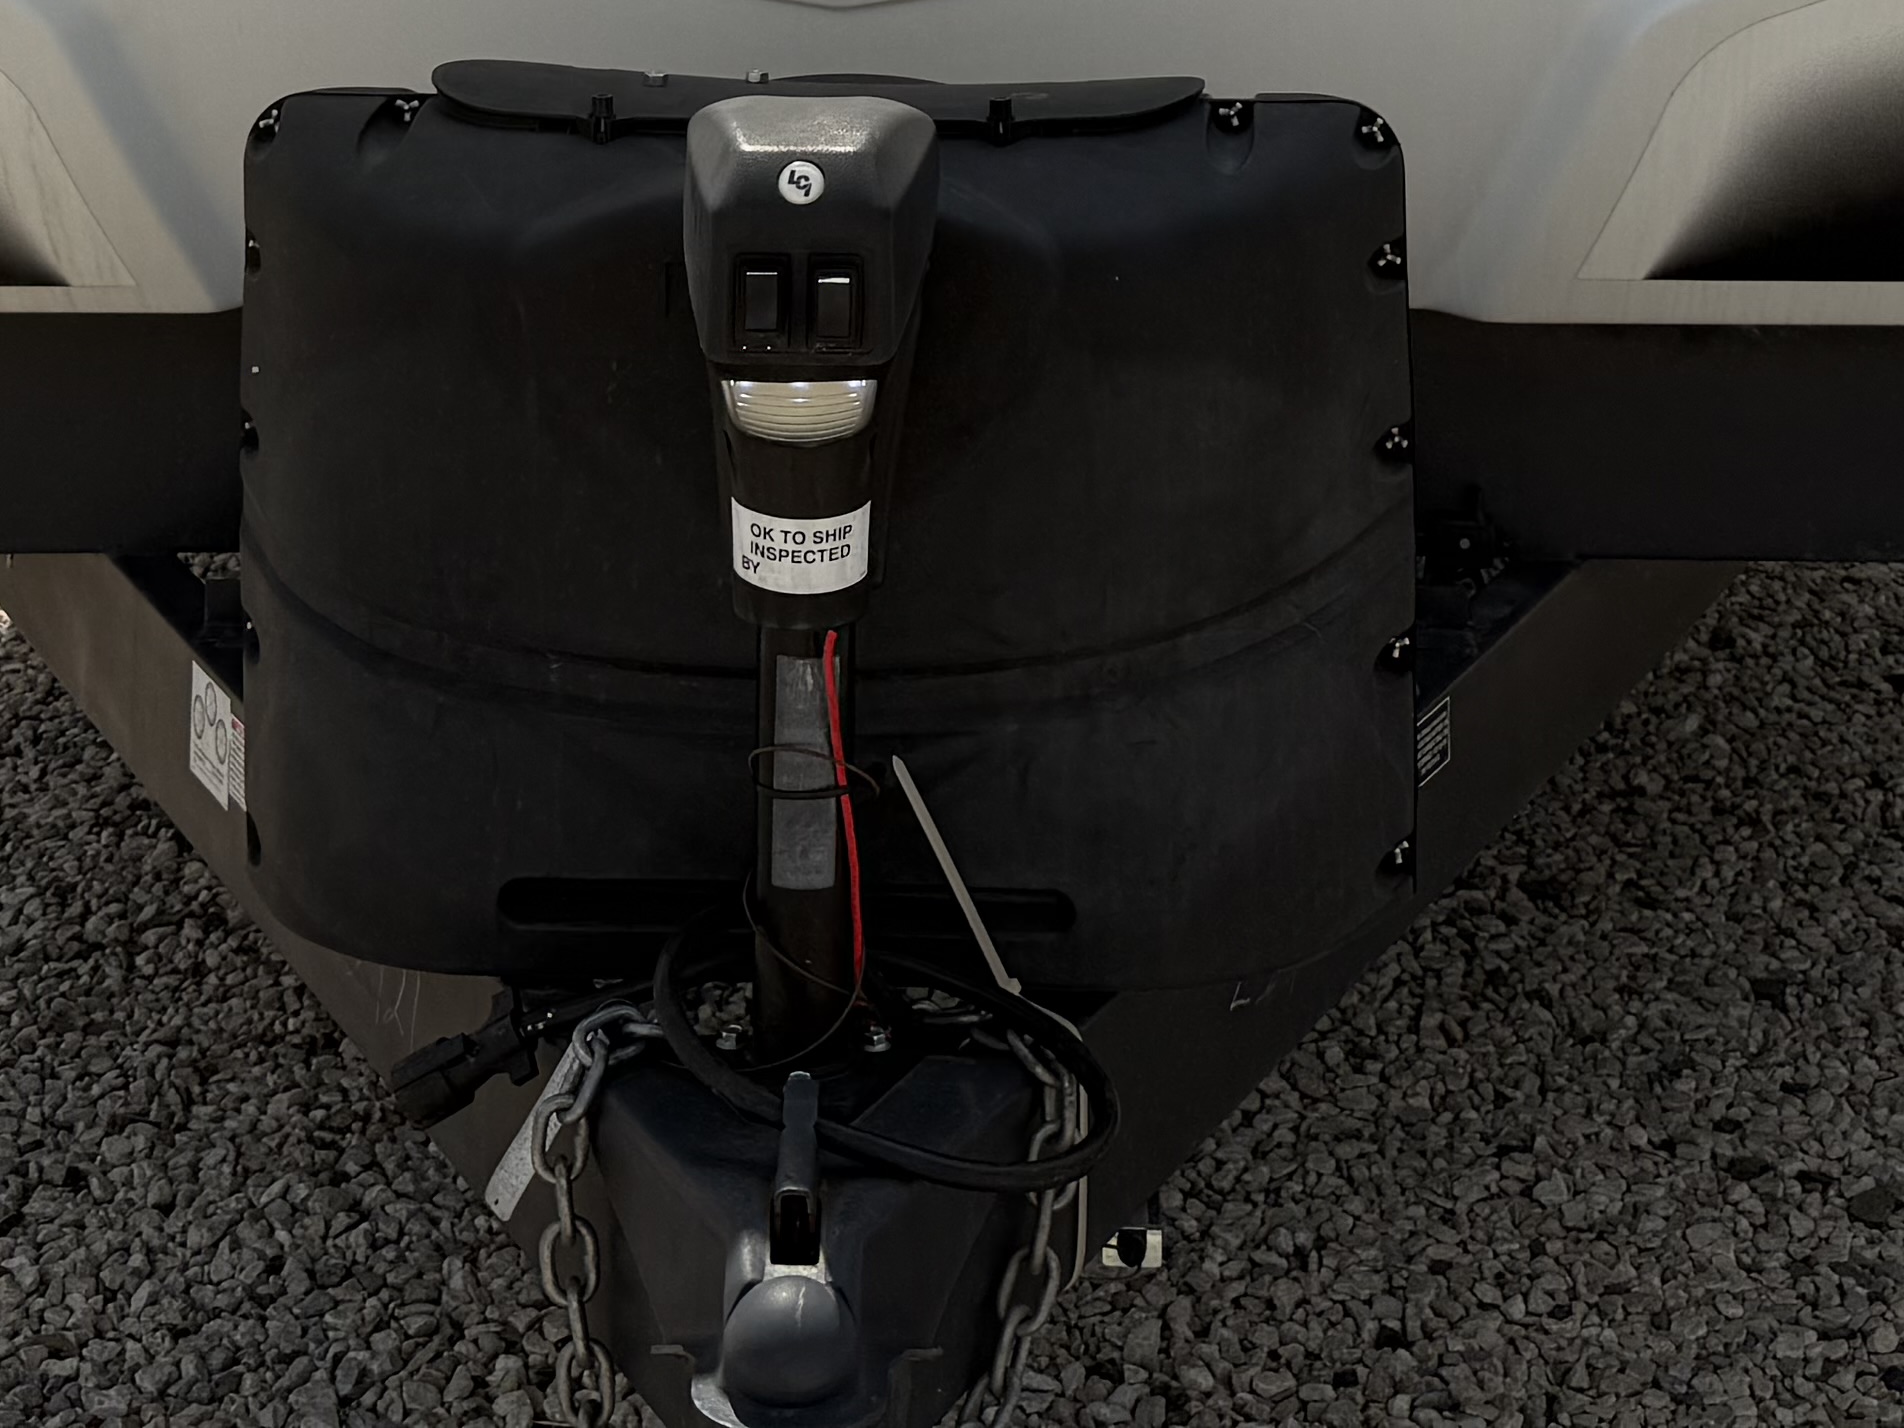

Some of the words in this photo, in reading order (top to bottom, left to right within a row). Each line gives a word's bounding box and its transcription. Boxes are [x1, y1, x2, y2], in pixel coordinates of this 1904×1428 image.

[750, 523, 774, 542] OK
[780, 530, 806, 545] TO
[813, 524, 852, 544] SHIP
[750, 541, 851, 564] INSPECTED
[742, 555, 760, 574] BY
